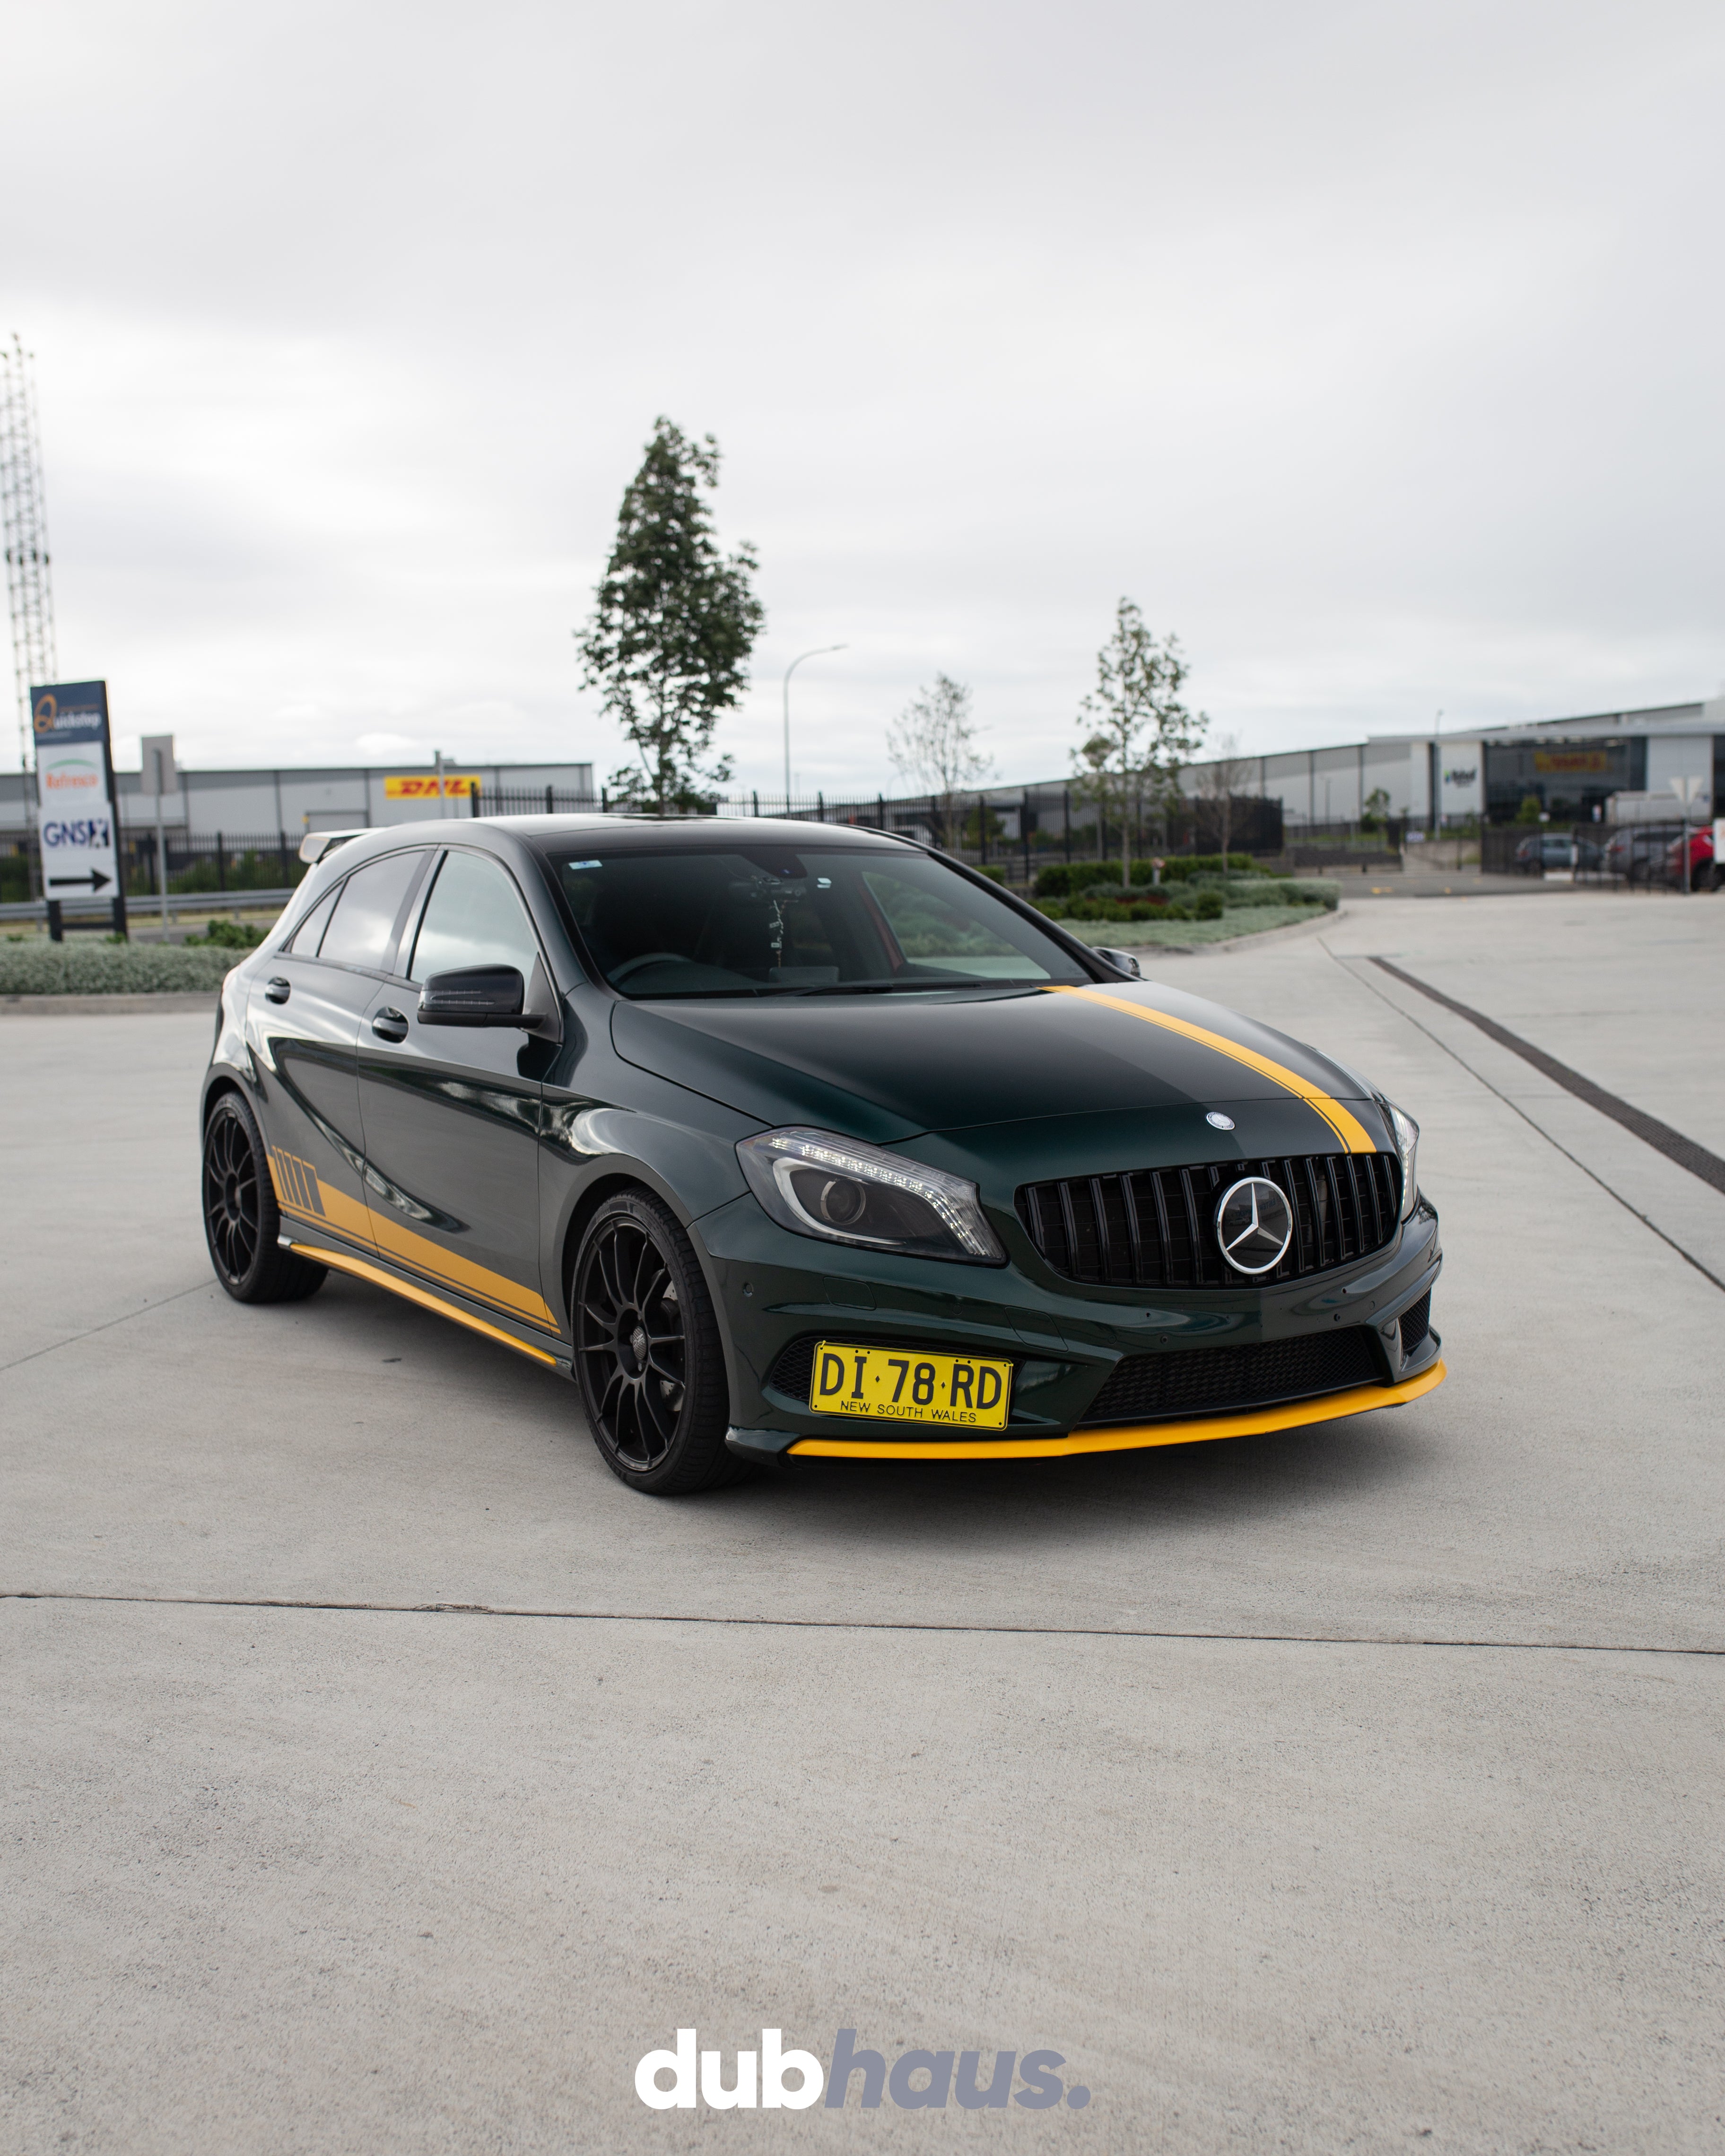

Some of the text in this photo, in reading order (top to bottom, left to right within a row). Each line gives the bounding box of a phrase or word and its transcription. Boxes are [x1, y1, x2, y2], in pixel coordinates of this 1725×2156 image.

[400, 781, 468, 795] DHL
[44, 820, 87, 847] GNS
[840, 1400, 977, 1423] NEW SOUTH WALES
